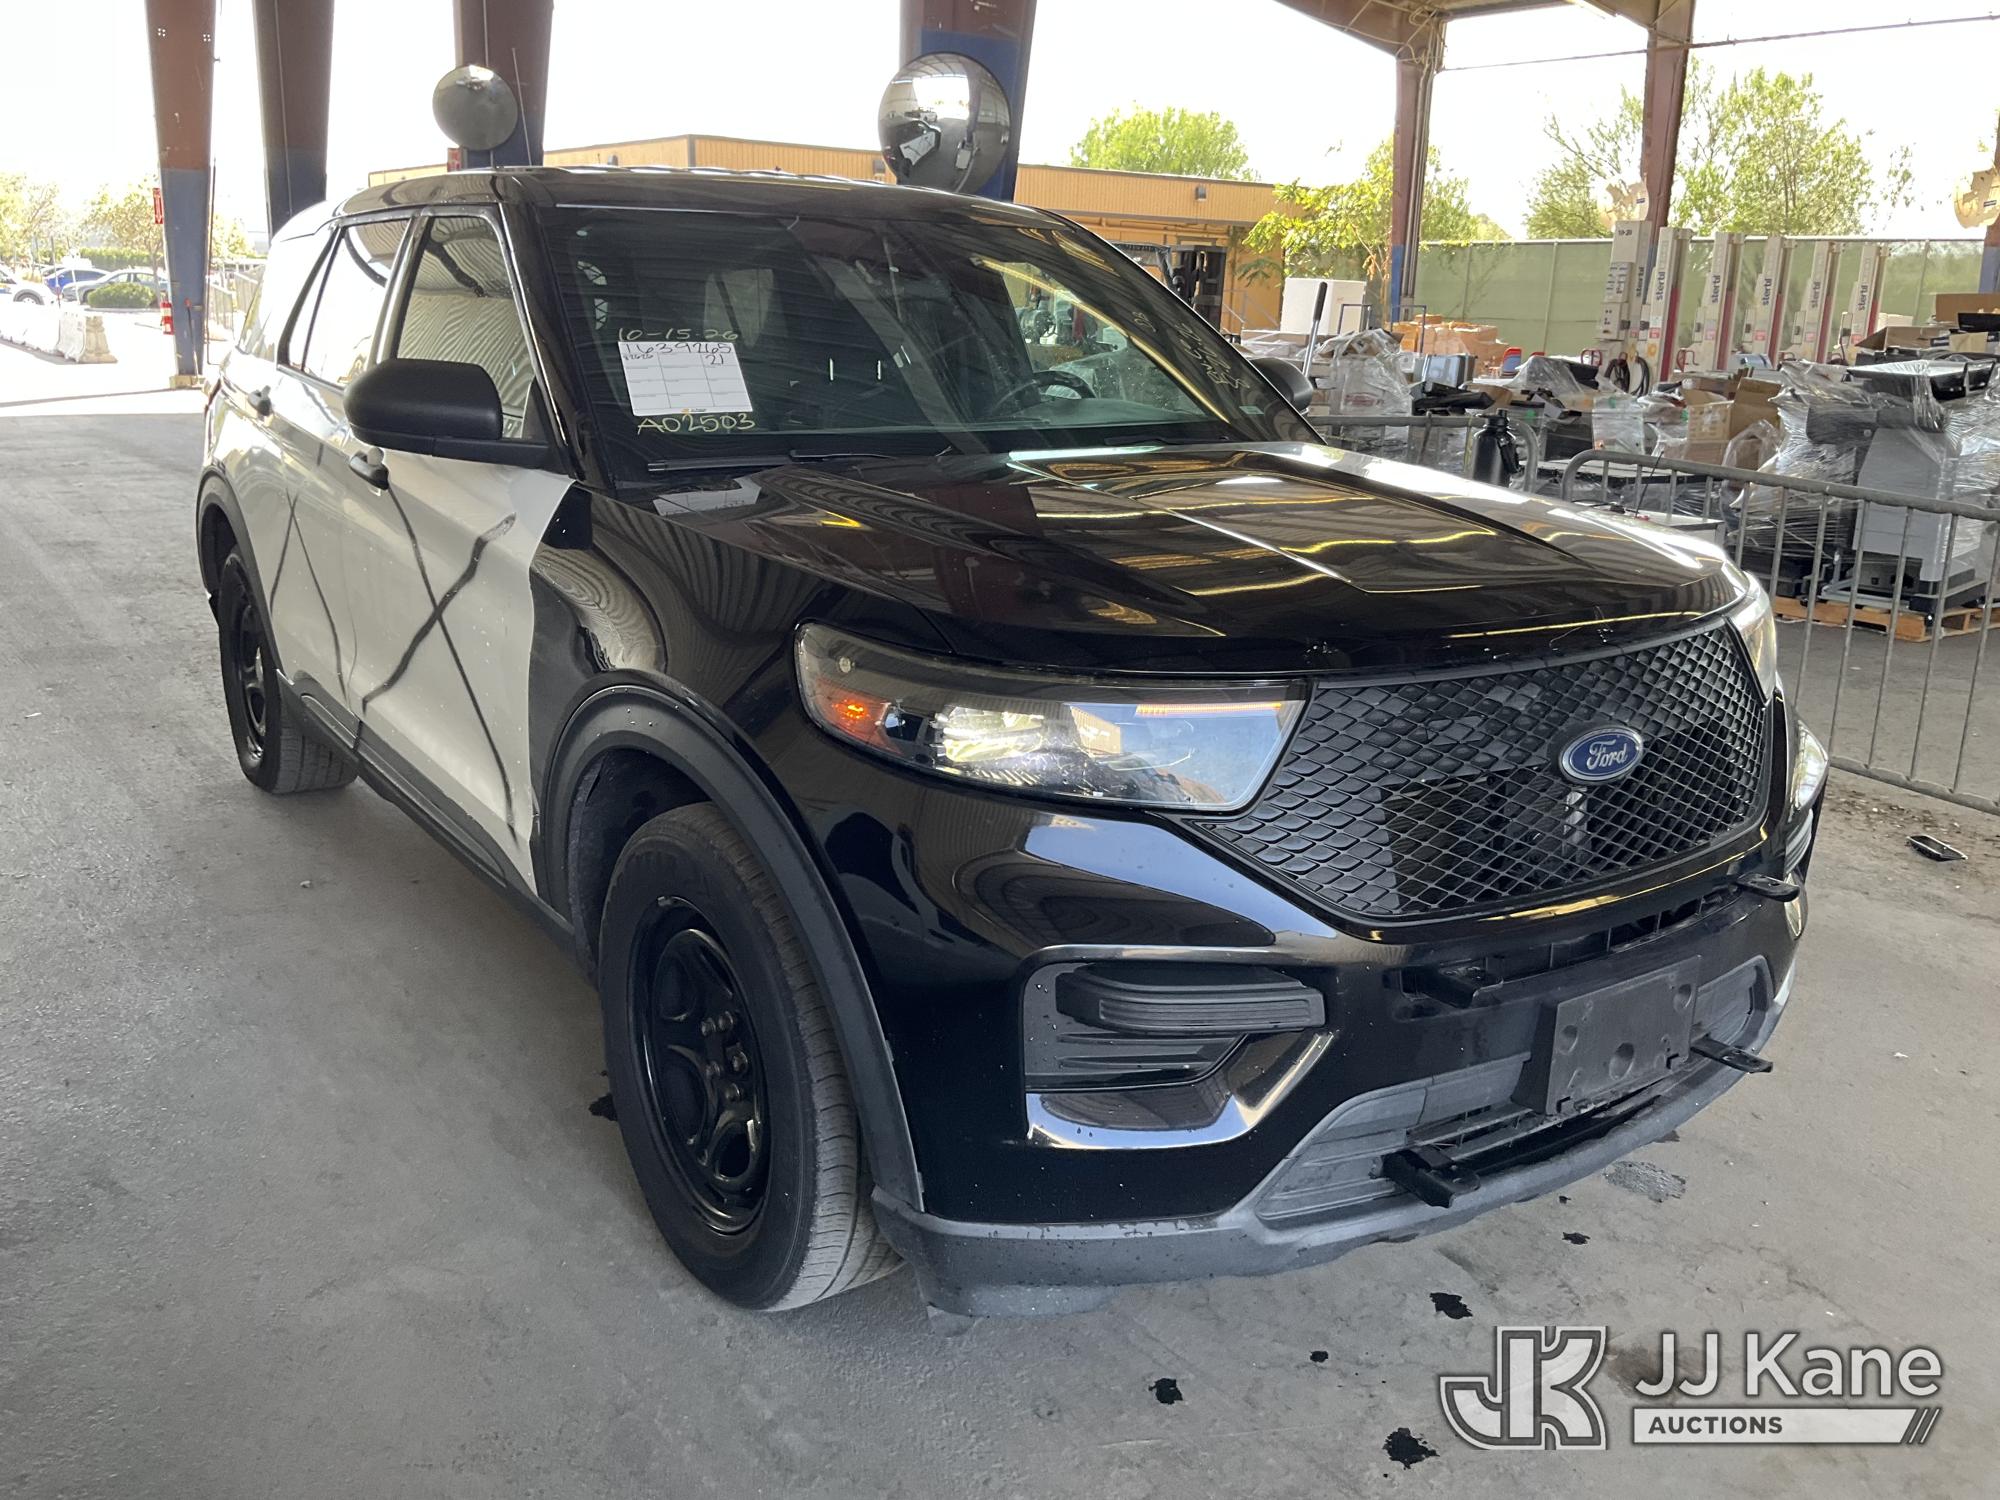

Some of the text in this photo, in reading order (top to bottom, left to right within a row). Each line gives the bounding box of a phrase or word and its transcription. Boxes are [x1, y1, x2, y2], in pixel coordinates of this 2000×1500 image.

[1655, 271, 1666, 301] stertil
[1712, 275, 1721, 303] stertil
[1762, 278, 1773, 306] stertil
[1811, 281, 1821, 308] stertil
[1857, 284, 1869, 311] stertil
[637, 412, 756, 436] A02503
[1586, 739, 1629, 770] Ford
